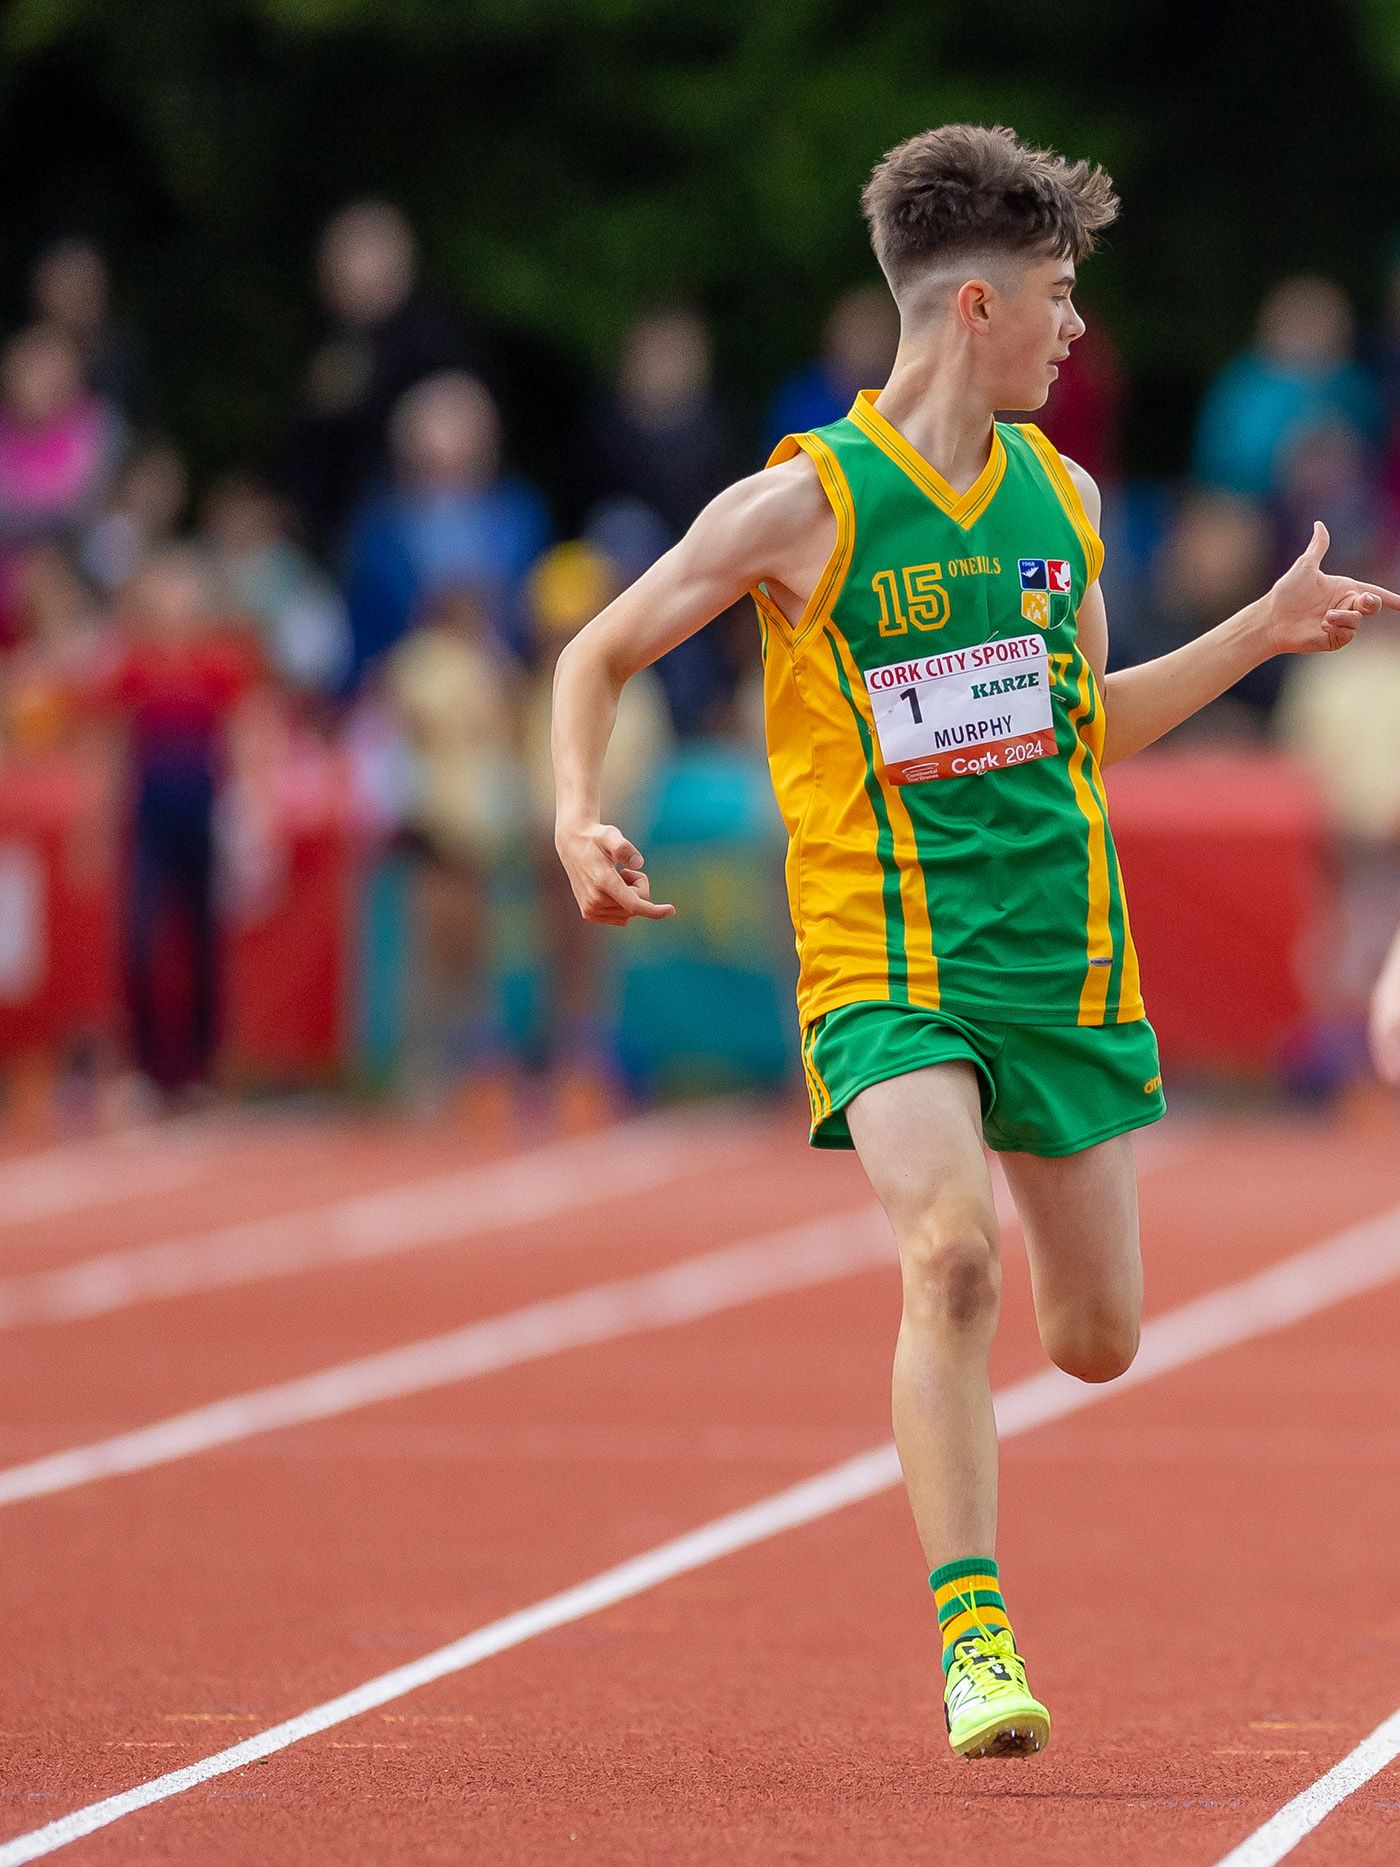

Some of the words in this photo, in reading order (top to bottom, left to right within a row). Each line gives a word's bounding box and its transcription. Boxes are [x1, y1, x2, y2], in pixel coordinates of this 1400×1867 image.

[872, 562, 950, 637] 15
[869, 658, 921, 690] CORK
[926, 651, 966, 678] CITY
[970, 637, 1040, 668] SPORTS
[971, 672, 1040, 699] KARZE
[900, 687, 923, 725] 1
[934, 715, 1013, 749] MURPHY
[951, 752, 998, 775] Cork
[1004, 740, 1044, 764] 2024
